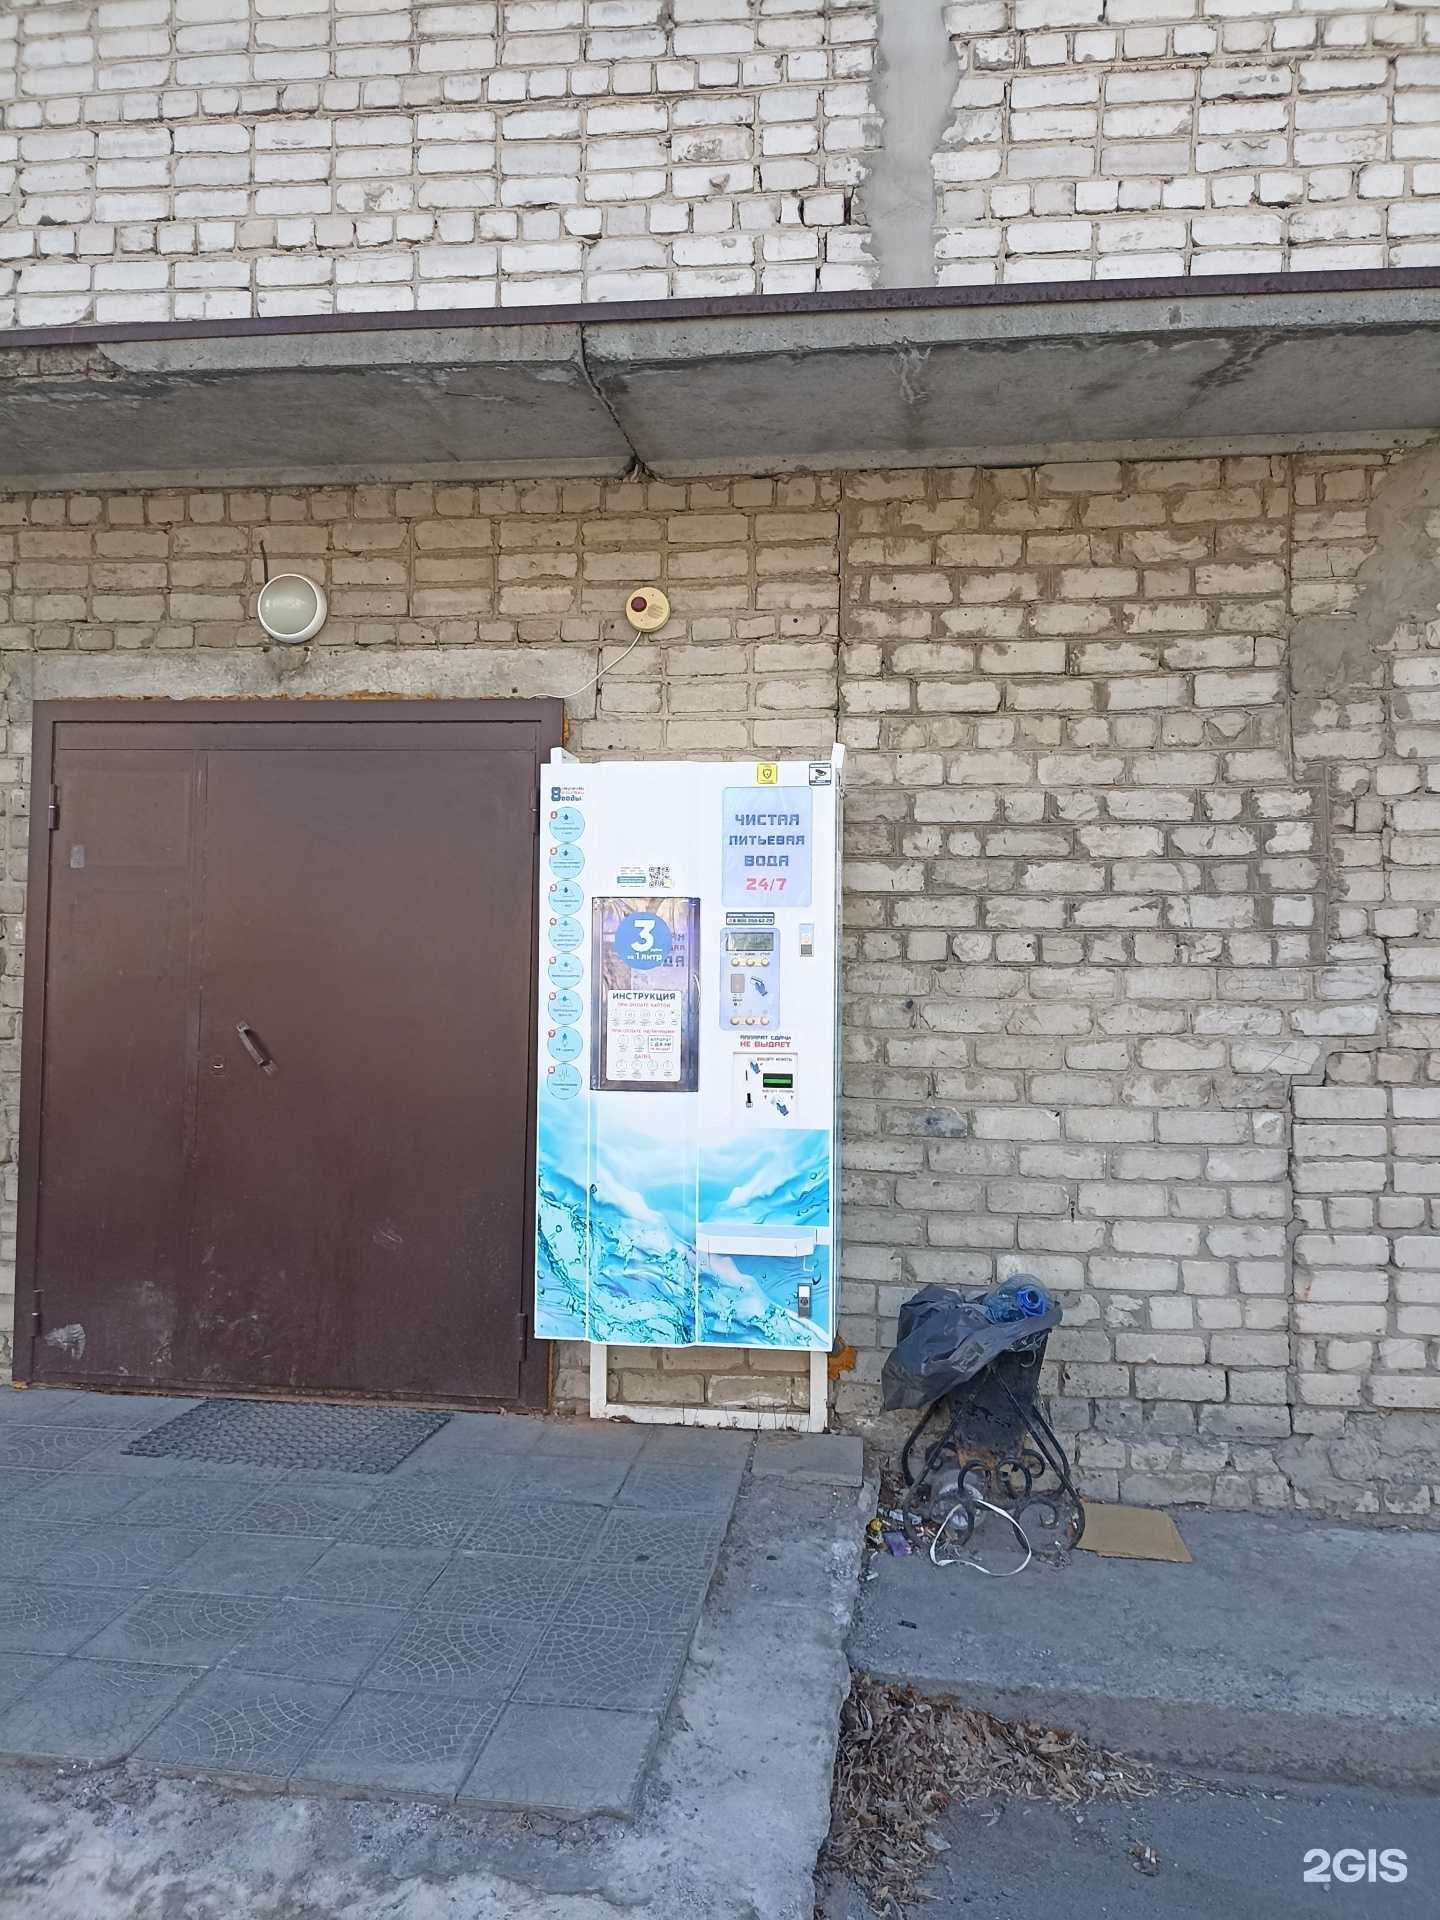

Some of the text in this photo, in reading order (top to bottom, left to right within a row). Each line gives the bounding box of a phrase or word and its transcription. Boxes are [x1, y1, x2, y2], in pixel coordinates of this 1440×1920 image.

[735, 813, 800, 826] ЧИСТАЯ
[728, 835, 805, 846] ПИТЬЕВАЯ
[744, 855, 789, 867] ВОДА
[746, 878, 787, 891] 24/7
[631, 919, 656, 952] 3
[612, 992, 676, 1002] ИНСТРУКЦИЯ
